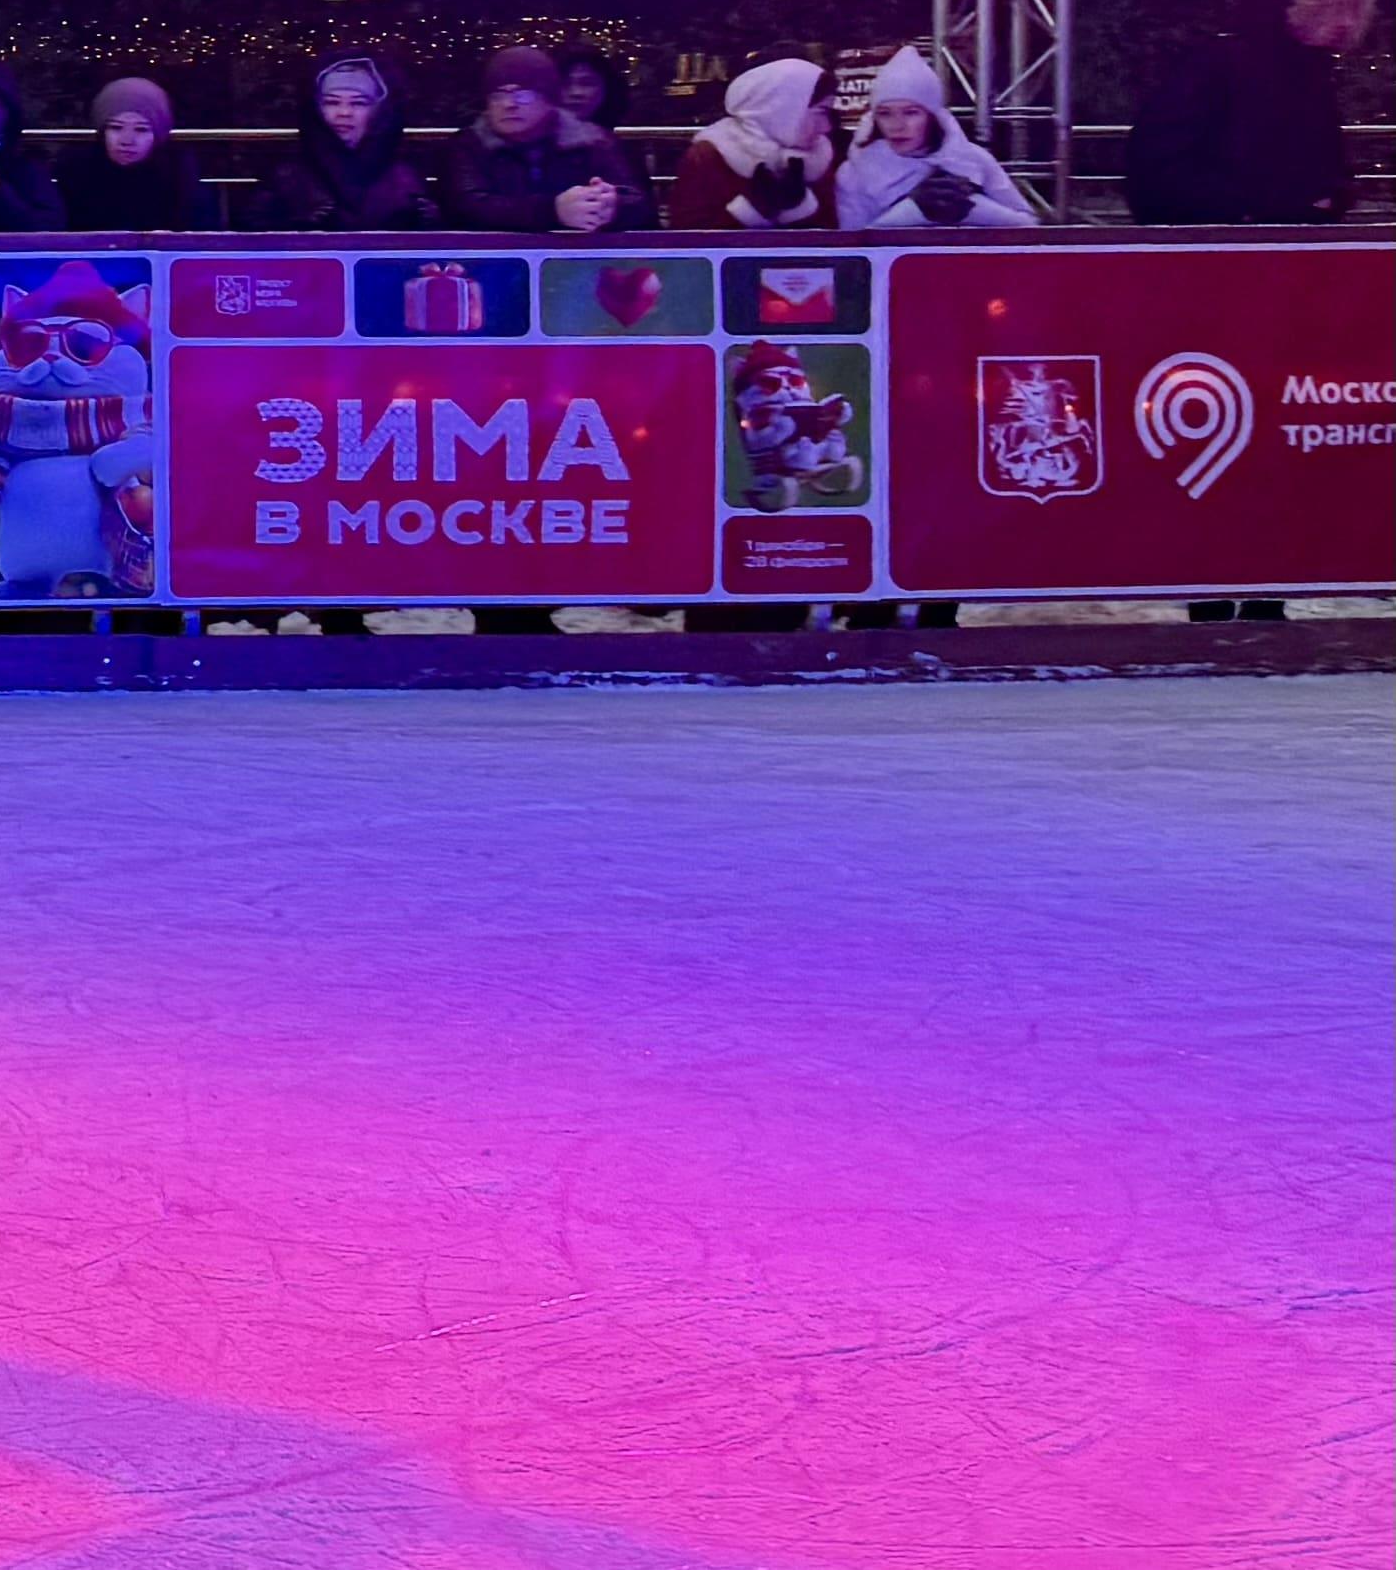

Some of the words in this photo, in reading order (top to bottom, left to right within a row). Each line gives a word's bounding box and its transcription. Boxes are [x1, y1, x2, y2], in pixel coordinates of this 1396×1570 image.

[254, 397, 630, 483] ЗИМА
[255, 500, 301, 545] В
[328, 499, 630, 545] МОСКВЕ
